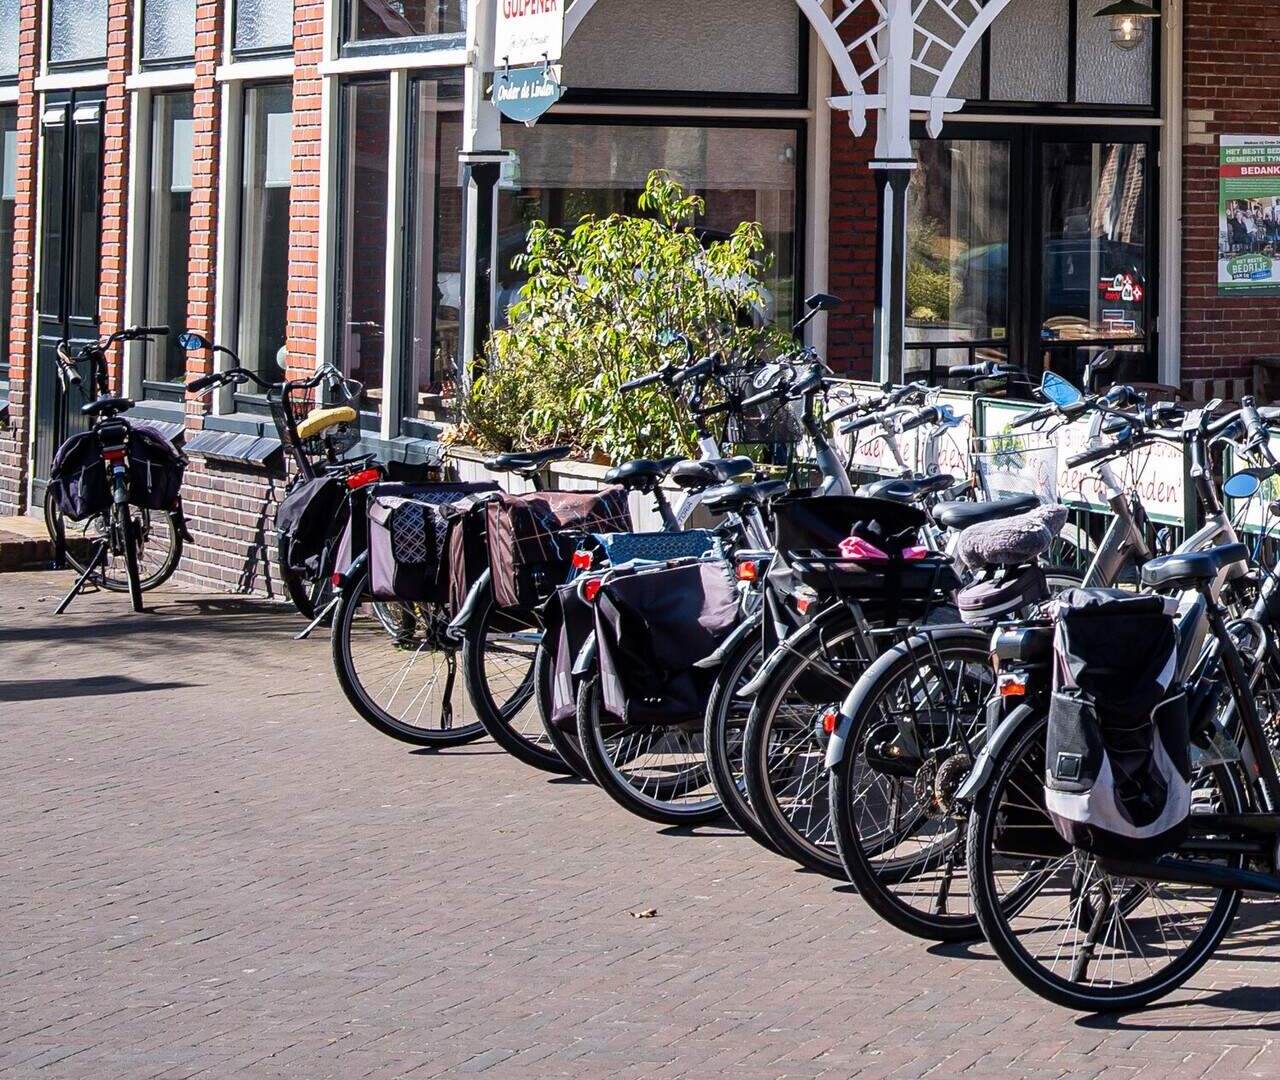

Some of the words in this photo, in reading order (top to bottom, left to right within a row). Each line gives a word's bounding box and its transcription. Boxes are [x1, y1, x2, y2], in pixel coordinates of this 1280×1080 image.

[498, 82, 521, 101] Onder
[521, 81, 530, 99] de
[531, 80, 554, 98] Linden
[1232, 261, 1267, 273] BEDRIJF
